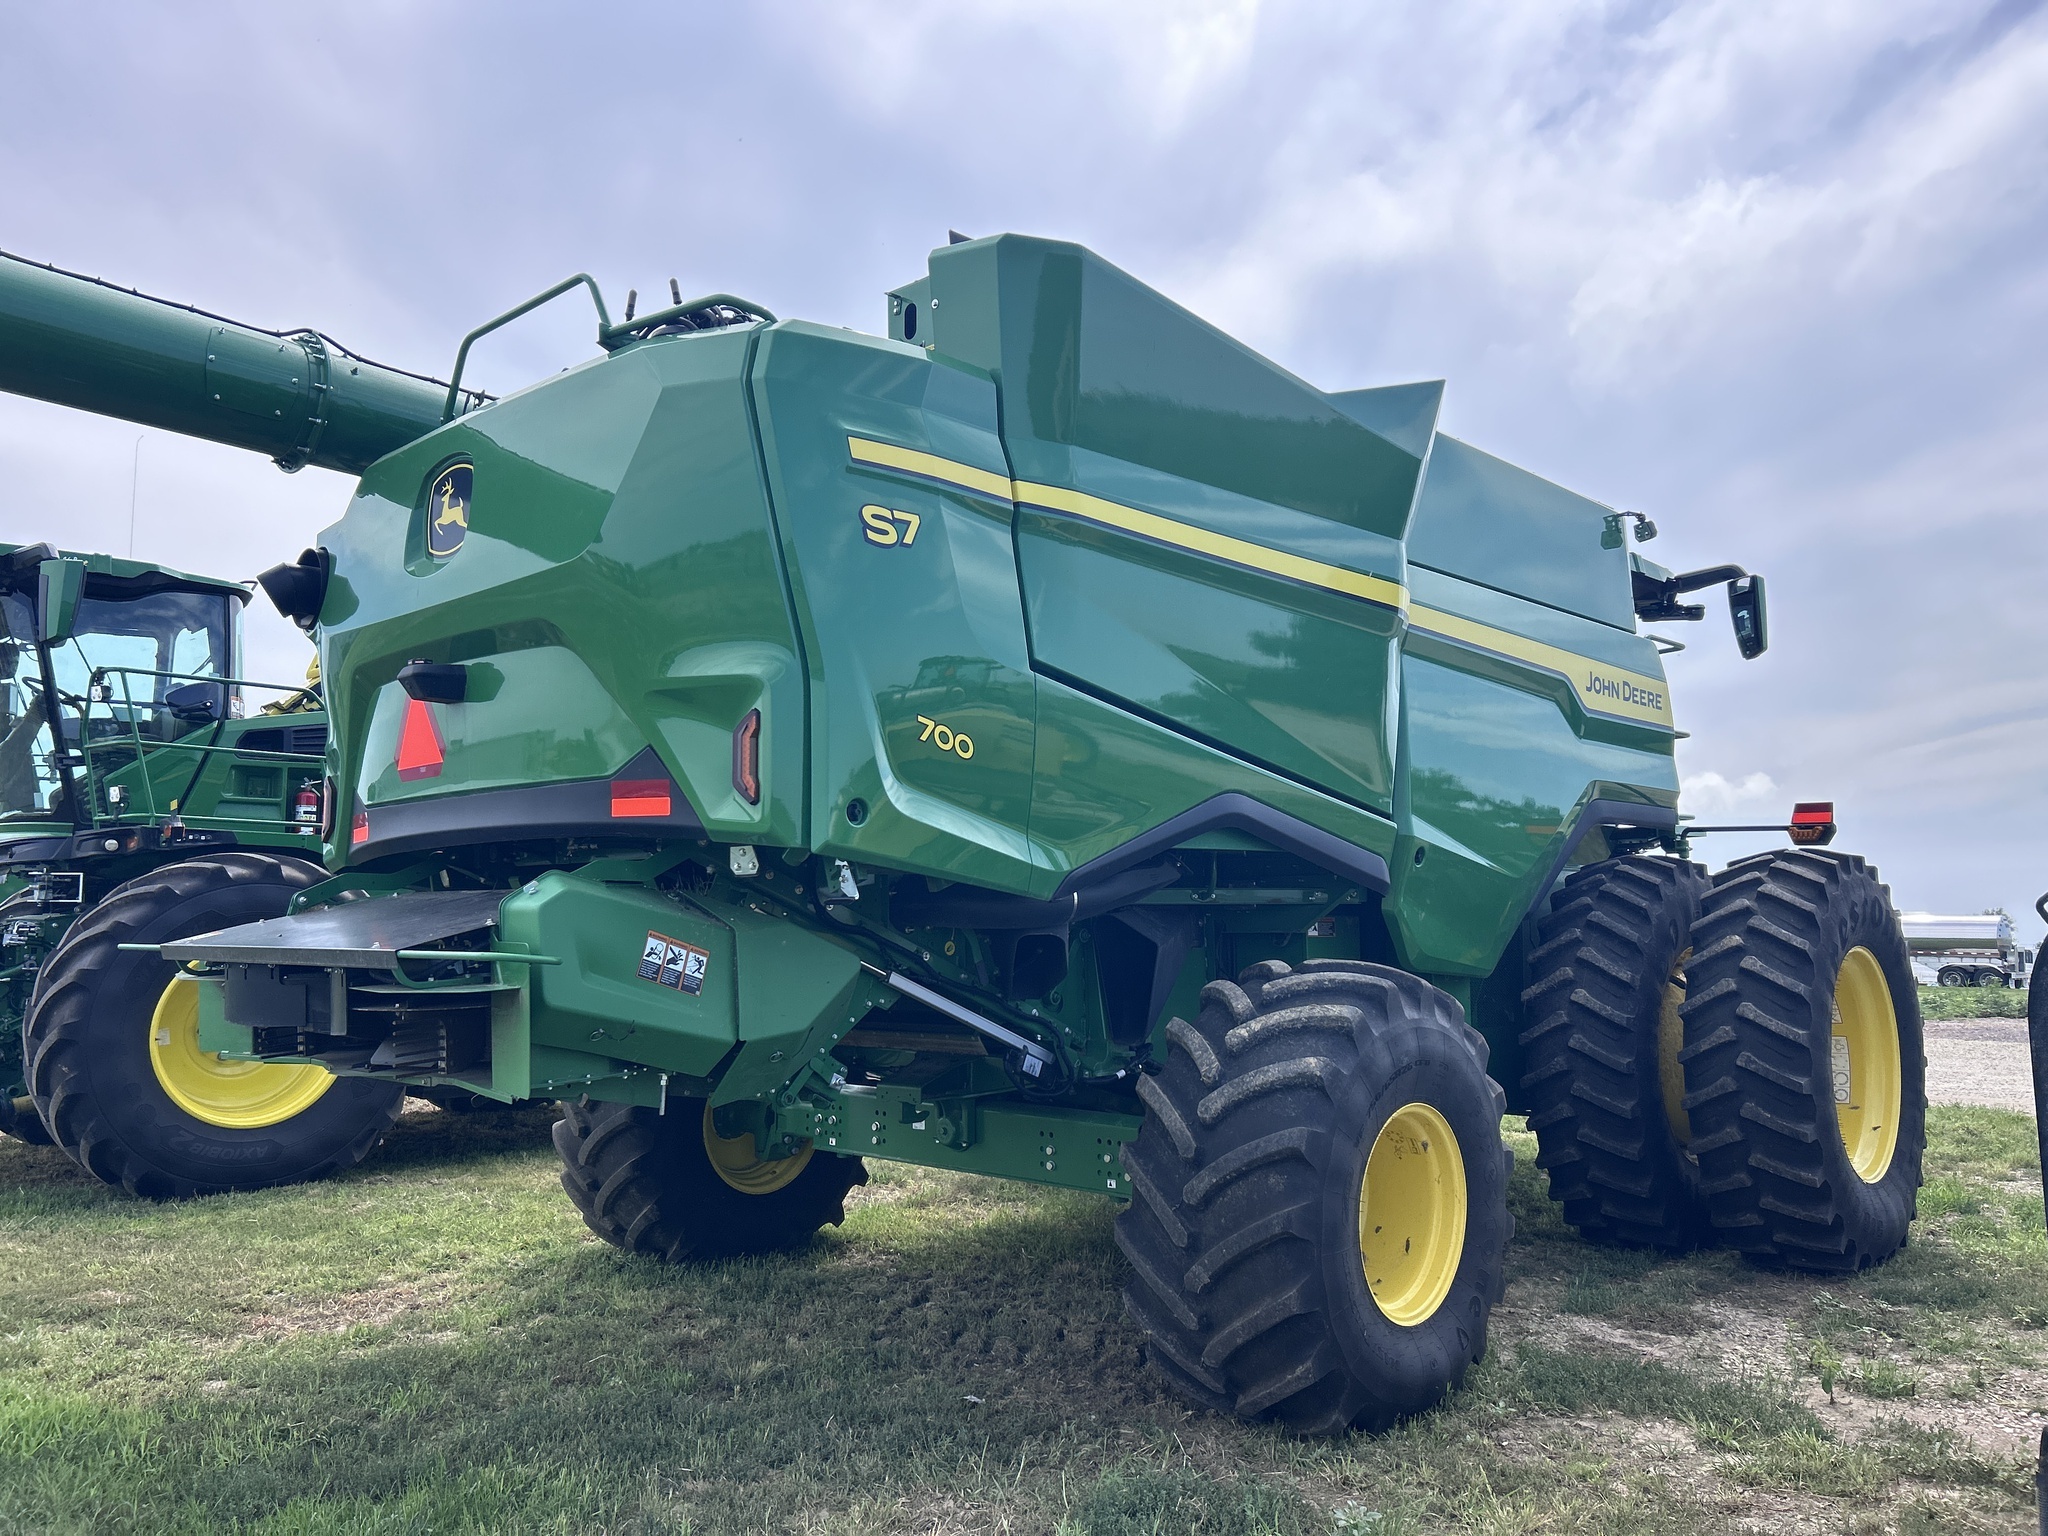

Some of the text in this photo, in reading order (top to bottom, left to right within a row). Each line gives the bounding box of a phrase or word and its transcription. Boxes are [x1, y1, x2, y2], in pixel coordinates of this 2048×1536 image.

[860, 503, 921, 548] S7
[1586, 671, 1663, 711] JOHN DEERE
[917, 714, 975, 760] 700
